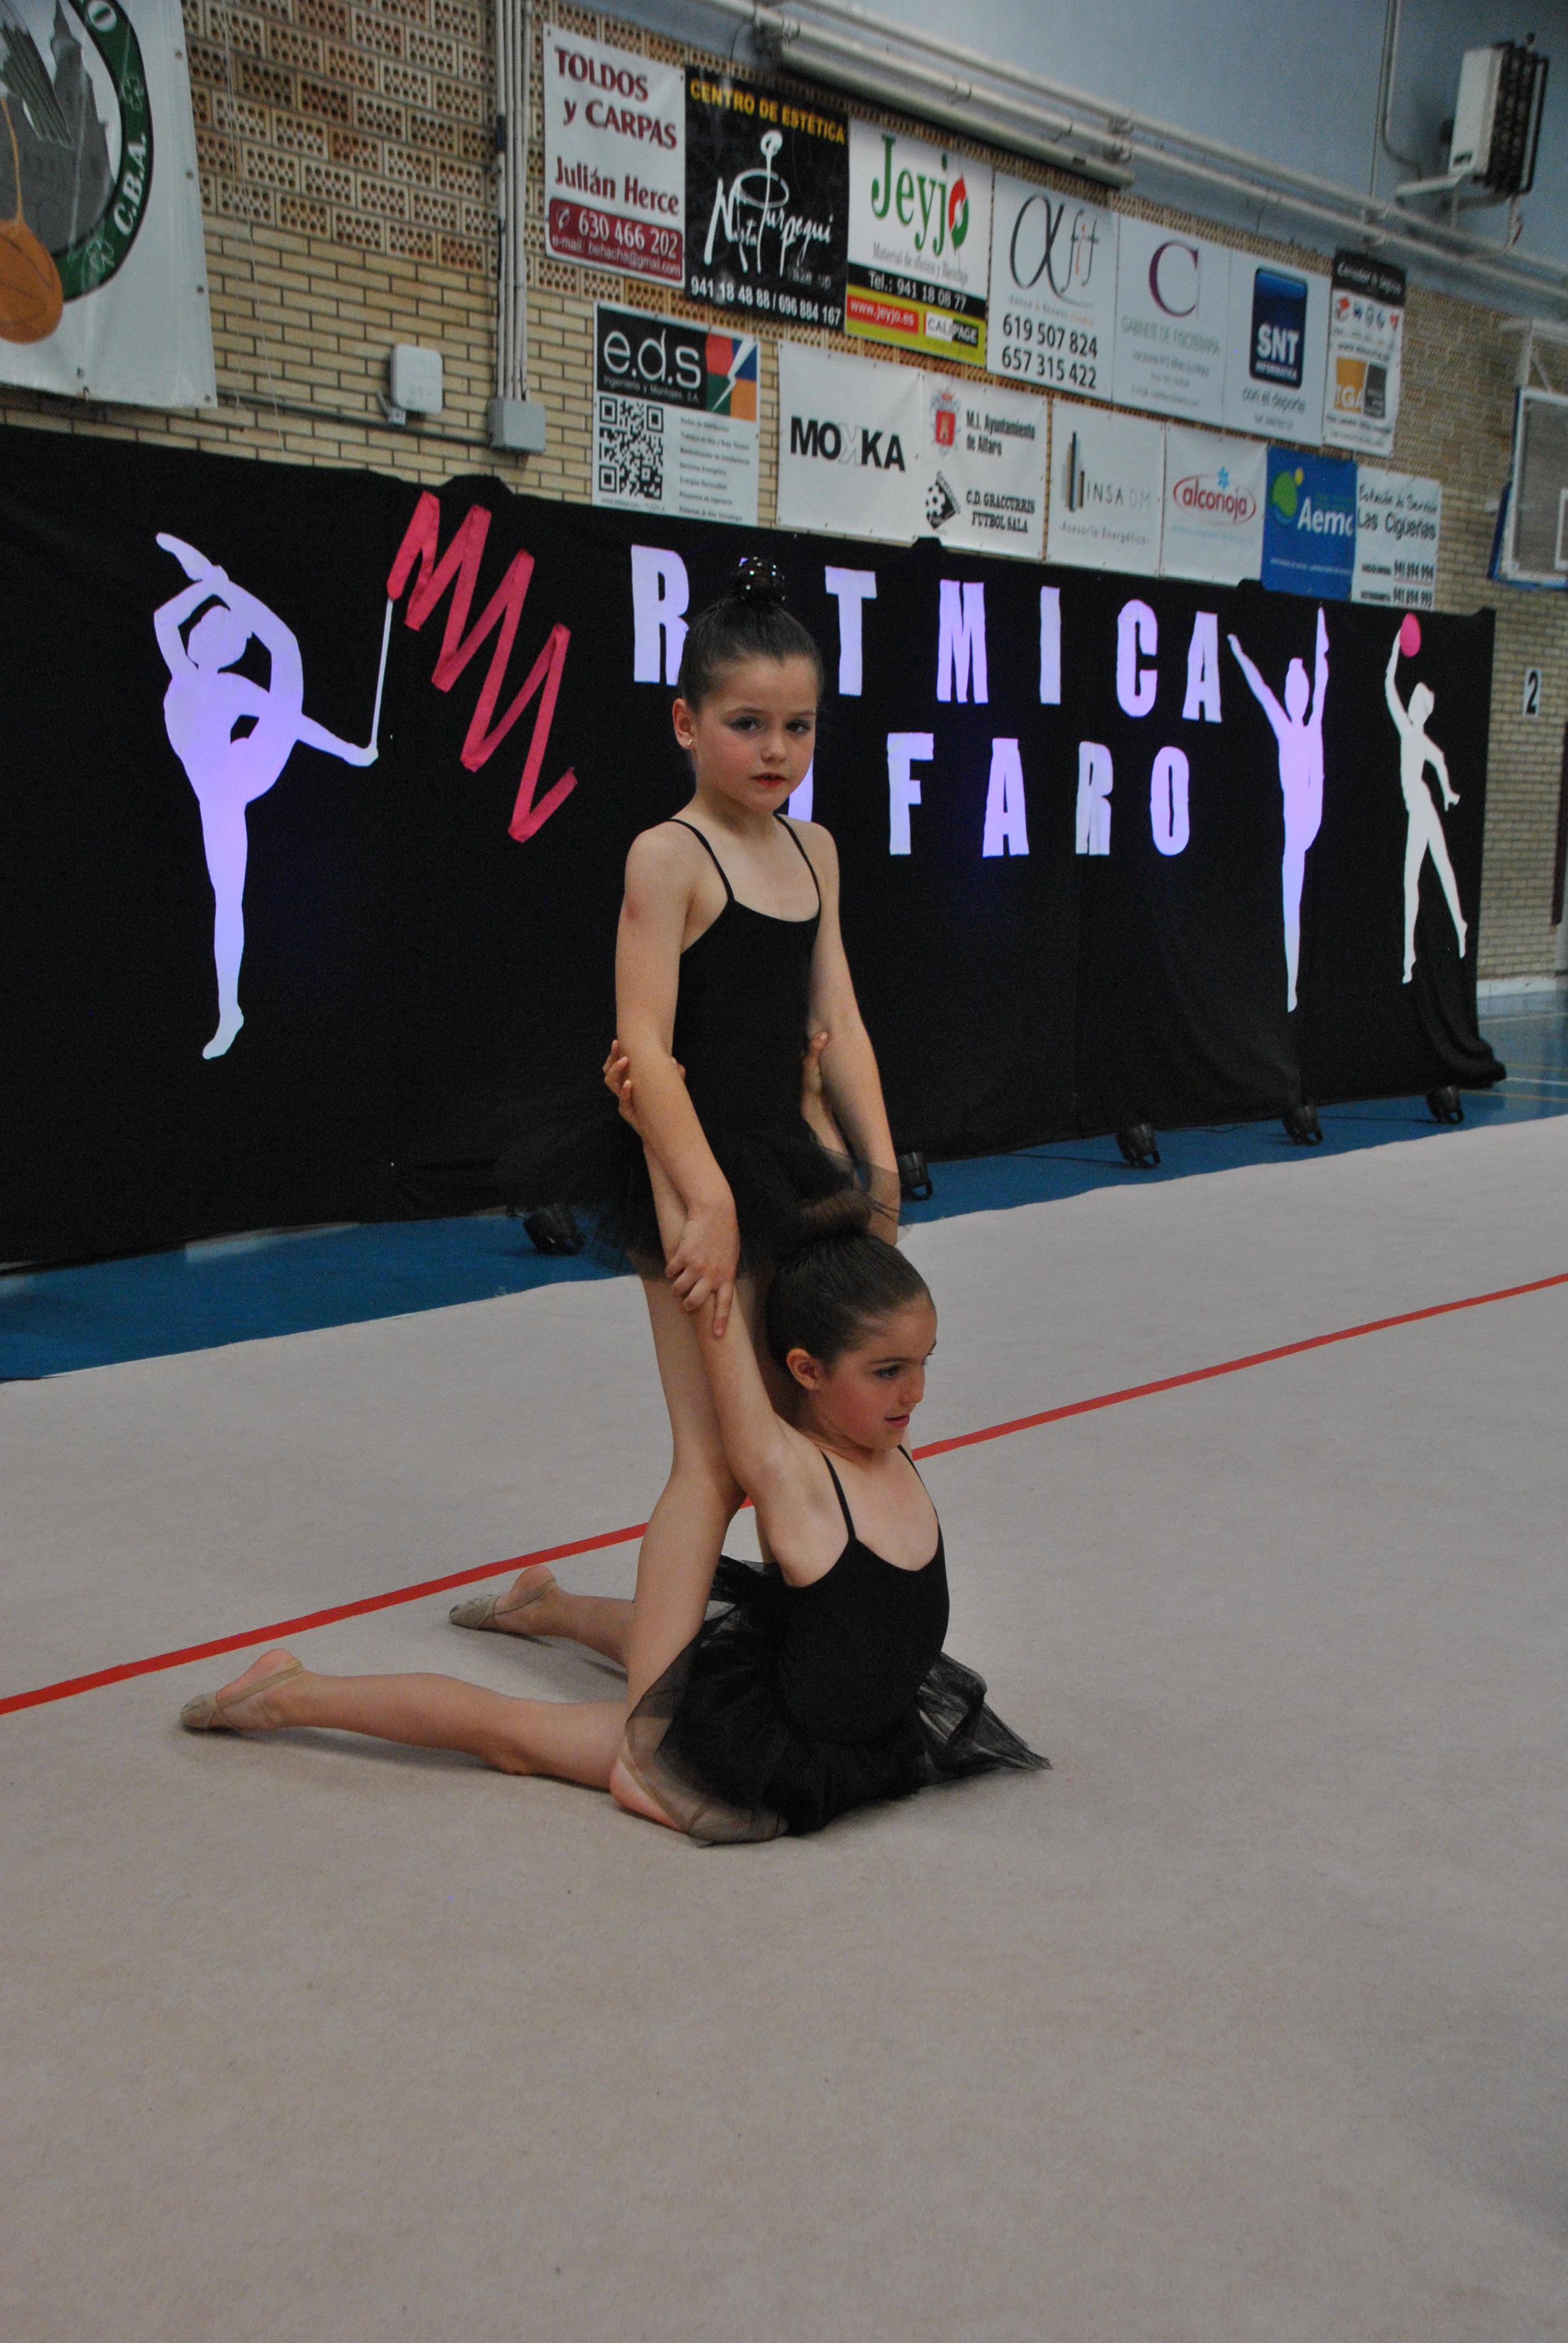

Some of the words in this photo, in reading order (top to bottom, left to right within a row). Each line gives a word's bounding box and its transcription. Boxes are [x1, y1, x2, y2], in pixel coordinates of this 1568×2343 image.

[554, 46, 648, 103] TOLDOS
[690, 78, 754, 114] CENTRO
[759, 98, 777, 122] DE
[564, 99, 577, 126] y
[586, 99, 677, 150] CARPAS
[556, 156, 616, 198] Julián
[624, 175, 679, 216] Herce
[578, 209, 609, 240] 630
[615, 219, 645, 252] 466
[650, 231, 678, 260] 202
[691, 277, 714, 298] 941
[719, 280, 734, 301] 18
[738, 284, 753, 304] 48
[756, 286, 770, 307] 88
[822, 303, 841, 326] 167
[850, 299, 914, 327] www.jeyjo.es
[897, 278, 917, 300] 941
[922, 285, 934, 304] 18
[938, 289, 951, 309] 08
[954, 292, 966, 312] 77
[1003, 315, 1033, 341] 619
[1037, 323, 1063, 351] 507
[1069, 330, 1097, 358] 824
[1256, 324, 1300, 363] SNT
[1002, 345, 1031, 372] 657
[1036, 353, 1065, 381] 315
[1069, 362, 1096, 389] 422
[985, 413, 1036, 441] Ayuntamiento
[967, 491, 981, 505] C.D.
[1183, 478, 1247, 522] alconoja
[972, 511, 1005, 529] FUTBOL
[1007, 514, 1028, 533] SALA
[1526, 670, 1539, 715] 2
